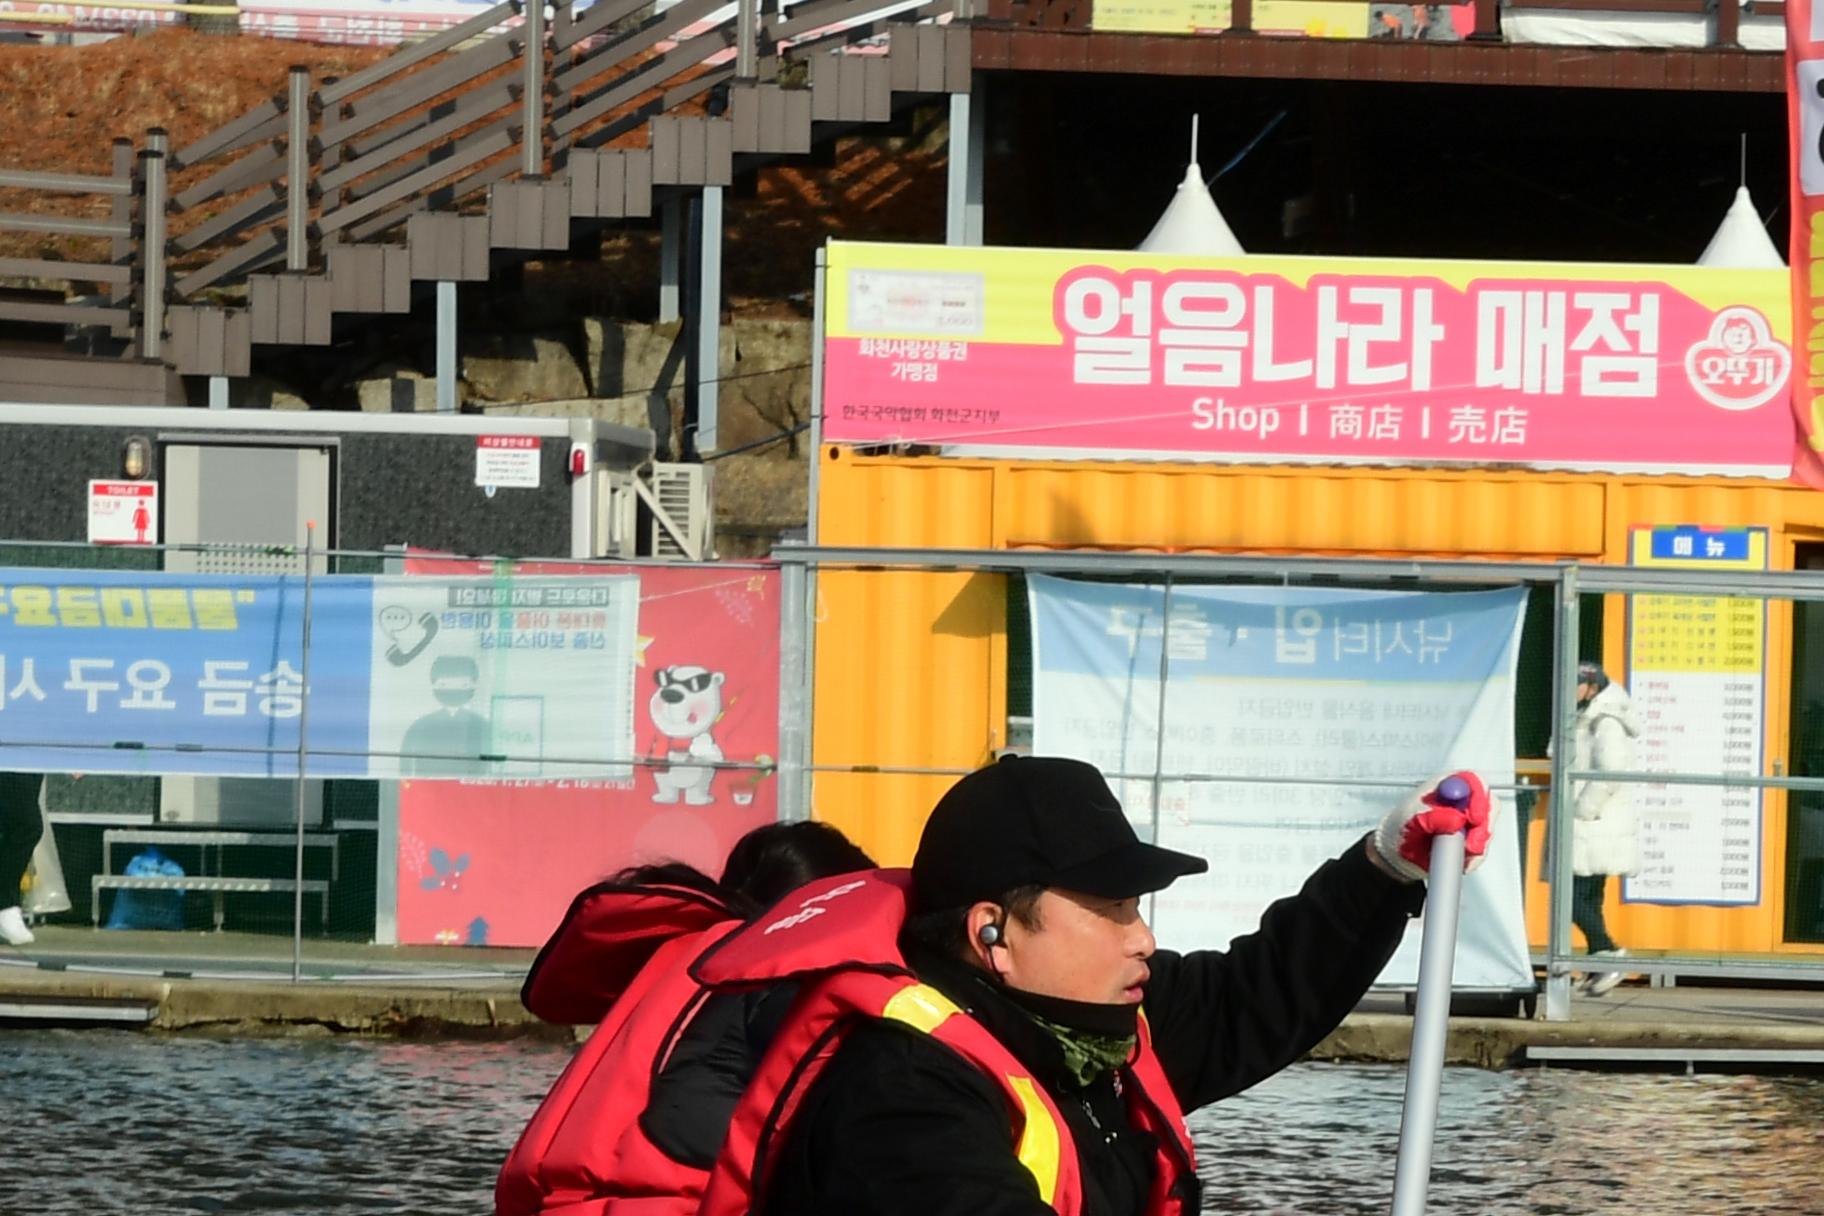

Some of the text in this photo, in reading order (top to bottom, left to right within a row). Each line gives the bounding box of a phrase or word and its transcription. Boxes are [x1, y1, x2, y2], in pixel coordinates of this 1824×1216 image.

[858, 338, 968, 361] 화천사랑상품권
[1063, 276, 1444, 391] 얼음나라
[1475, 290, 1660, 398] 매점
[891, 362, 938, 382] 가맹점
[1701, 356, 1775, 385] 오뚜기
[1192, 398, 1529, 445] Shop 商店 売店
